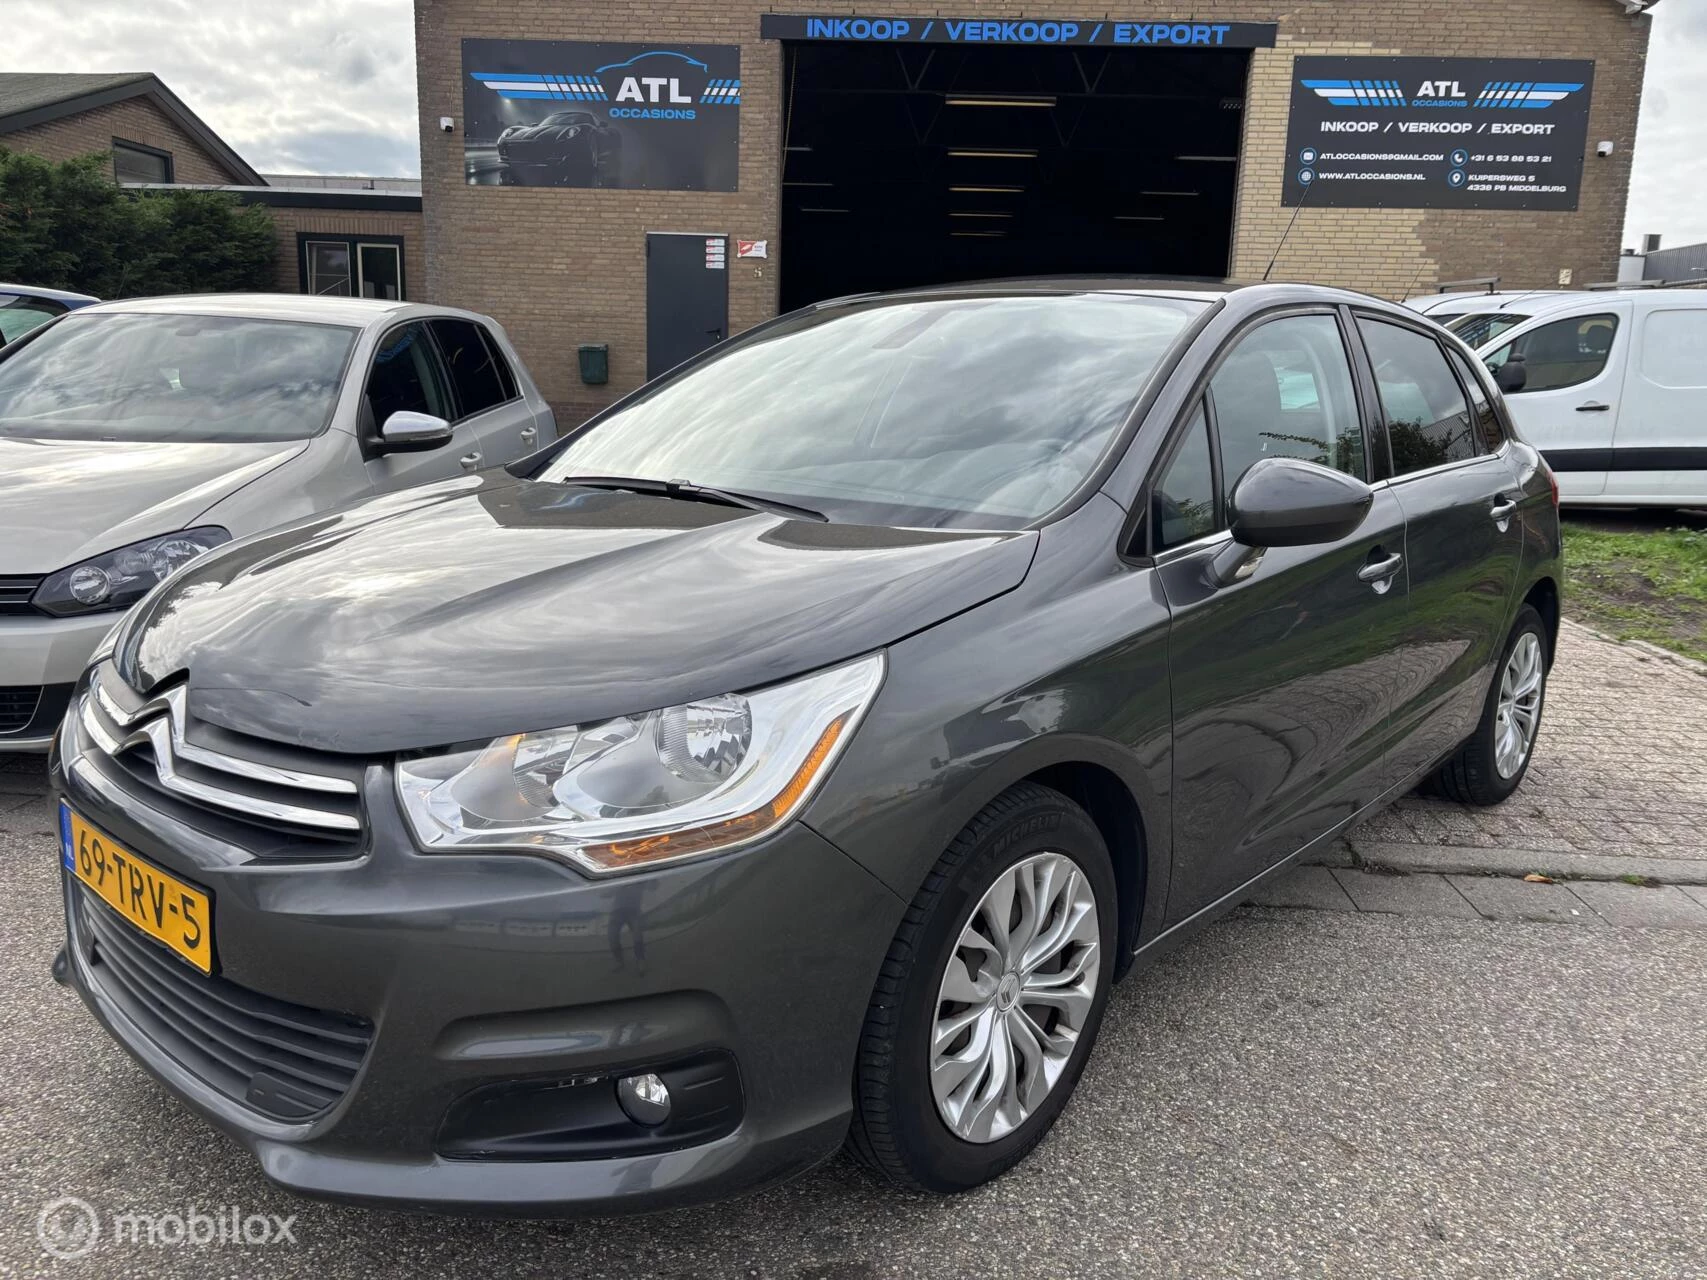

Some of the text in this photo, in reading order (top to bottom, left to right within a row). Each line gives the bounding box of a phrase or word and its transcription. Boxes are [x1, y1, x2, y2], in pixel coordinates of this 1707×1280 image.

[806, 19, 1230, 45] INKOOP / VERKOOP / EXPORT
[615, 76, 692, 103] ATL
[1416, 80, 1466, 98] ATL
[1411, 99, 1468, 108] OCCASIONS
[609, 107, 697, 120] OCCASIONS
[1320, 121, 1555, 135] INKOOP / VERKOOP / EXPORT
[1320, 153, 1444, 161] ATLOCCASIONS@GMAIL.COM
[1541, 155, 1552, 163] 21
[1319, 172, 1426, 180] WWW.ATLOCCASIONS.NL
[1468, 174, 1526, 182] KUIPERSWEG
[1508, 184, 1567, 193] MIDDELBURG
[80, 829, 201, 949] 69-TRV-5
